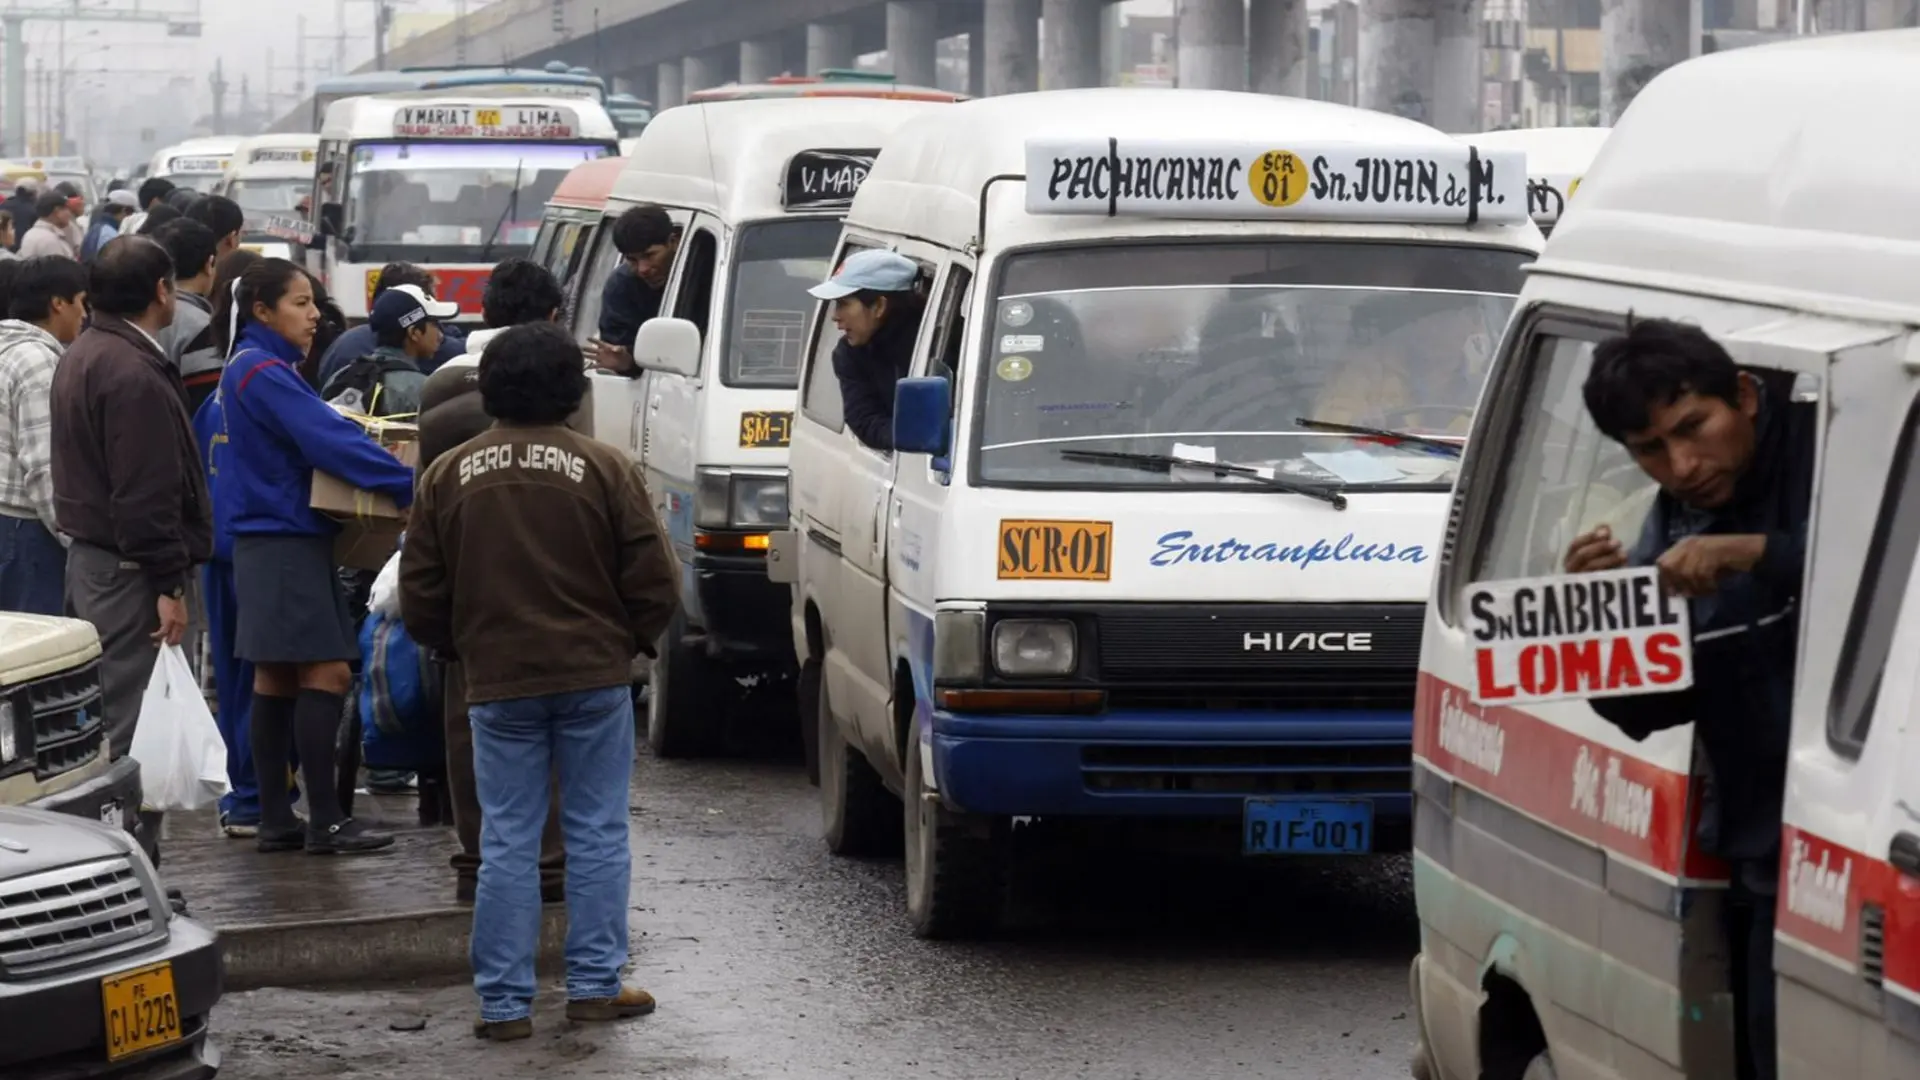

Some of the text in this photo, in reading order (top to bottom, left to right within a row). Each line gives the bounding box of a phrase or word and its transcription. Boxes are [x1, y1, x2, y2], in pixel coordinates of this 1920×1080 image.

[416, 109, 457, 125] MARIA
[518, 111, 561, 125] LIMA
[802, 166, 817, 192] V.
[1263, 153, 1295, 174] SCR
[1048, 156, 1241, 200] PACHACAMAC
[1352, 158, 1440, 204] JUAN
[1443, 173, 1467, 207] de
[1474, 159, 1505, 204] M.
[1263, 172, 1288, 202] 01
[459, 443, 586, 485] SERO JEANS
[1001, 526, 1107, 573] SCR-01
[1149, 531, 1429, 570] Entranplusa
[1514, 576, 1679, 638] GABRIEL
[1243, 632, 1373, 651] HIACE
[1476, 633, 1683, 700] LOMAS
